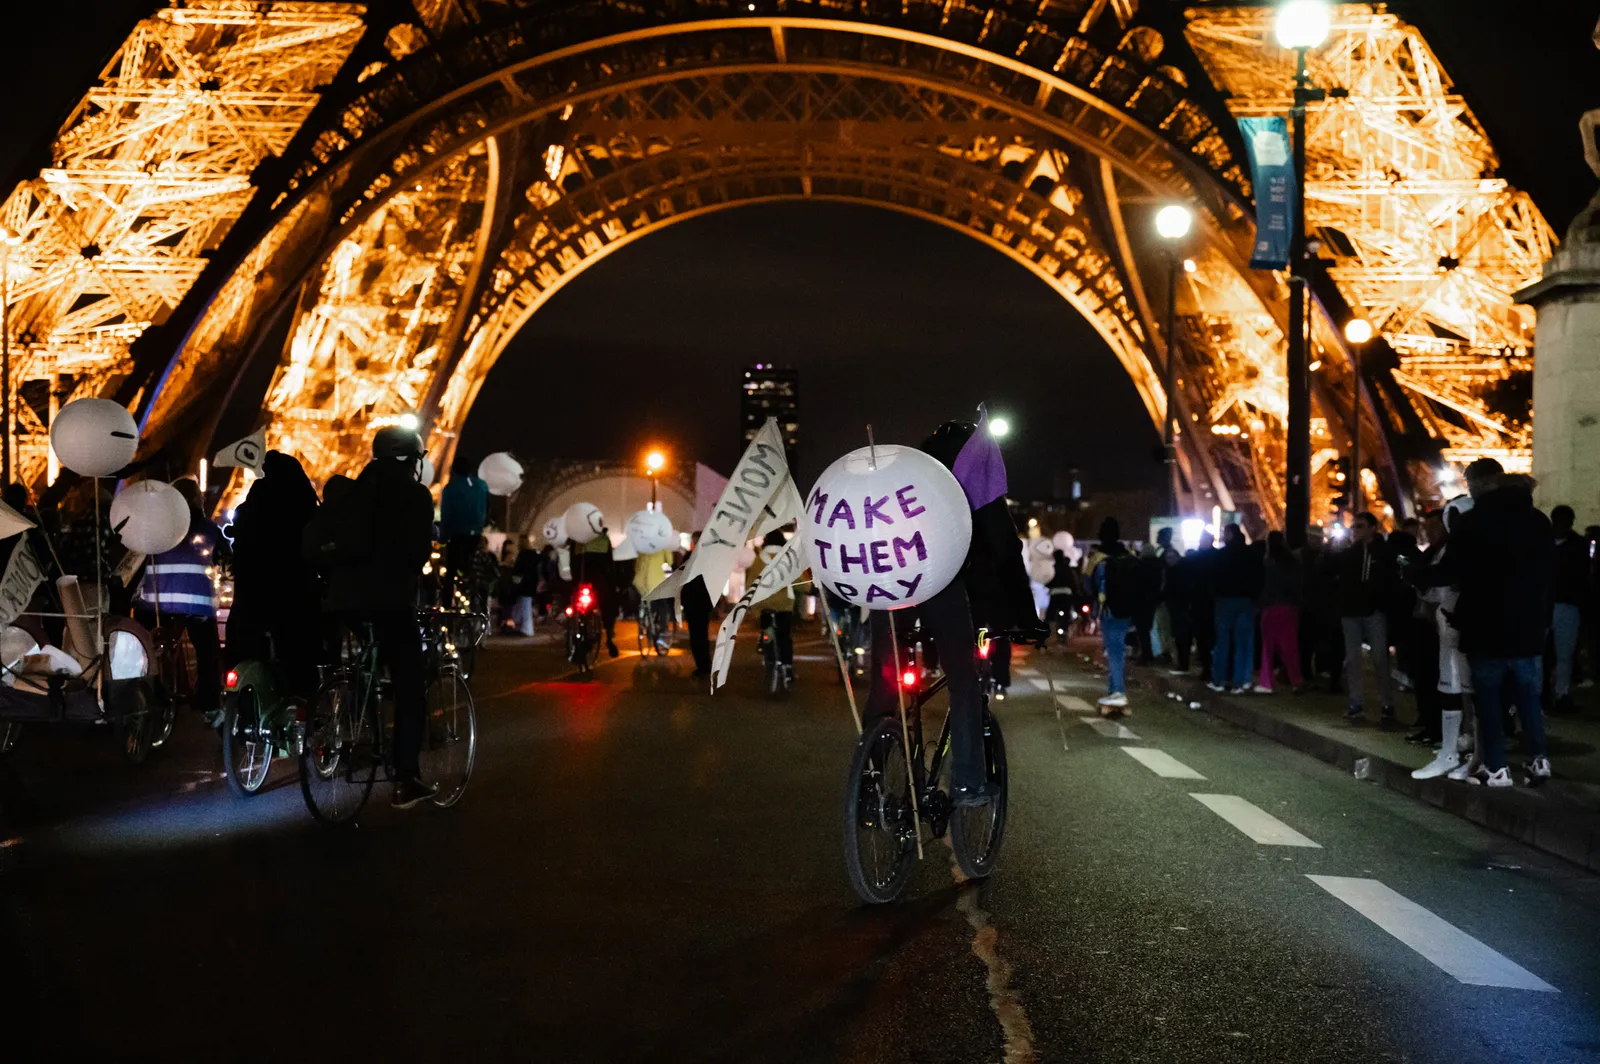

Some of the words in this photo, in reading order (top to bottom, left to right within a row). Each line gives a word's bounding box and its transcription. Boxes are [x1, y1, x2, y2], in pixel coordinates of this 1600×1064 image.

[806, 485, 926, 529] MAKE
[814, 530, 928, 574] THEM
[833, 573, 923, 603] PAY
